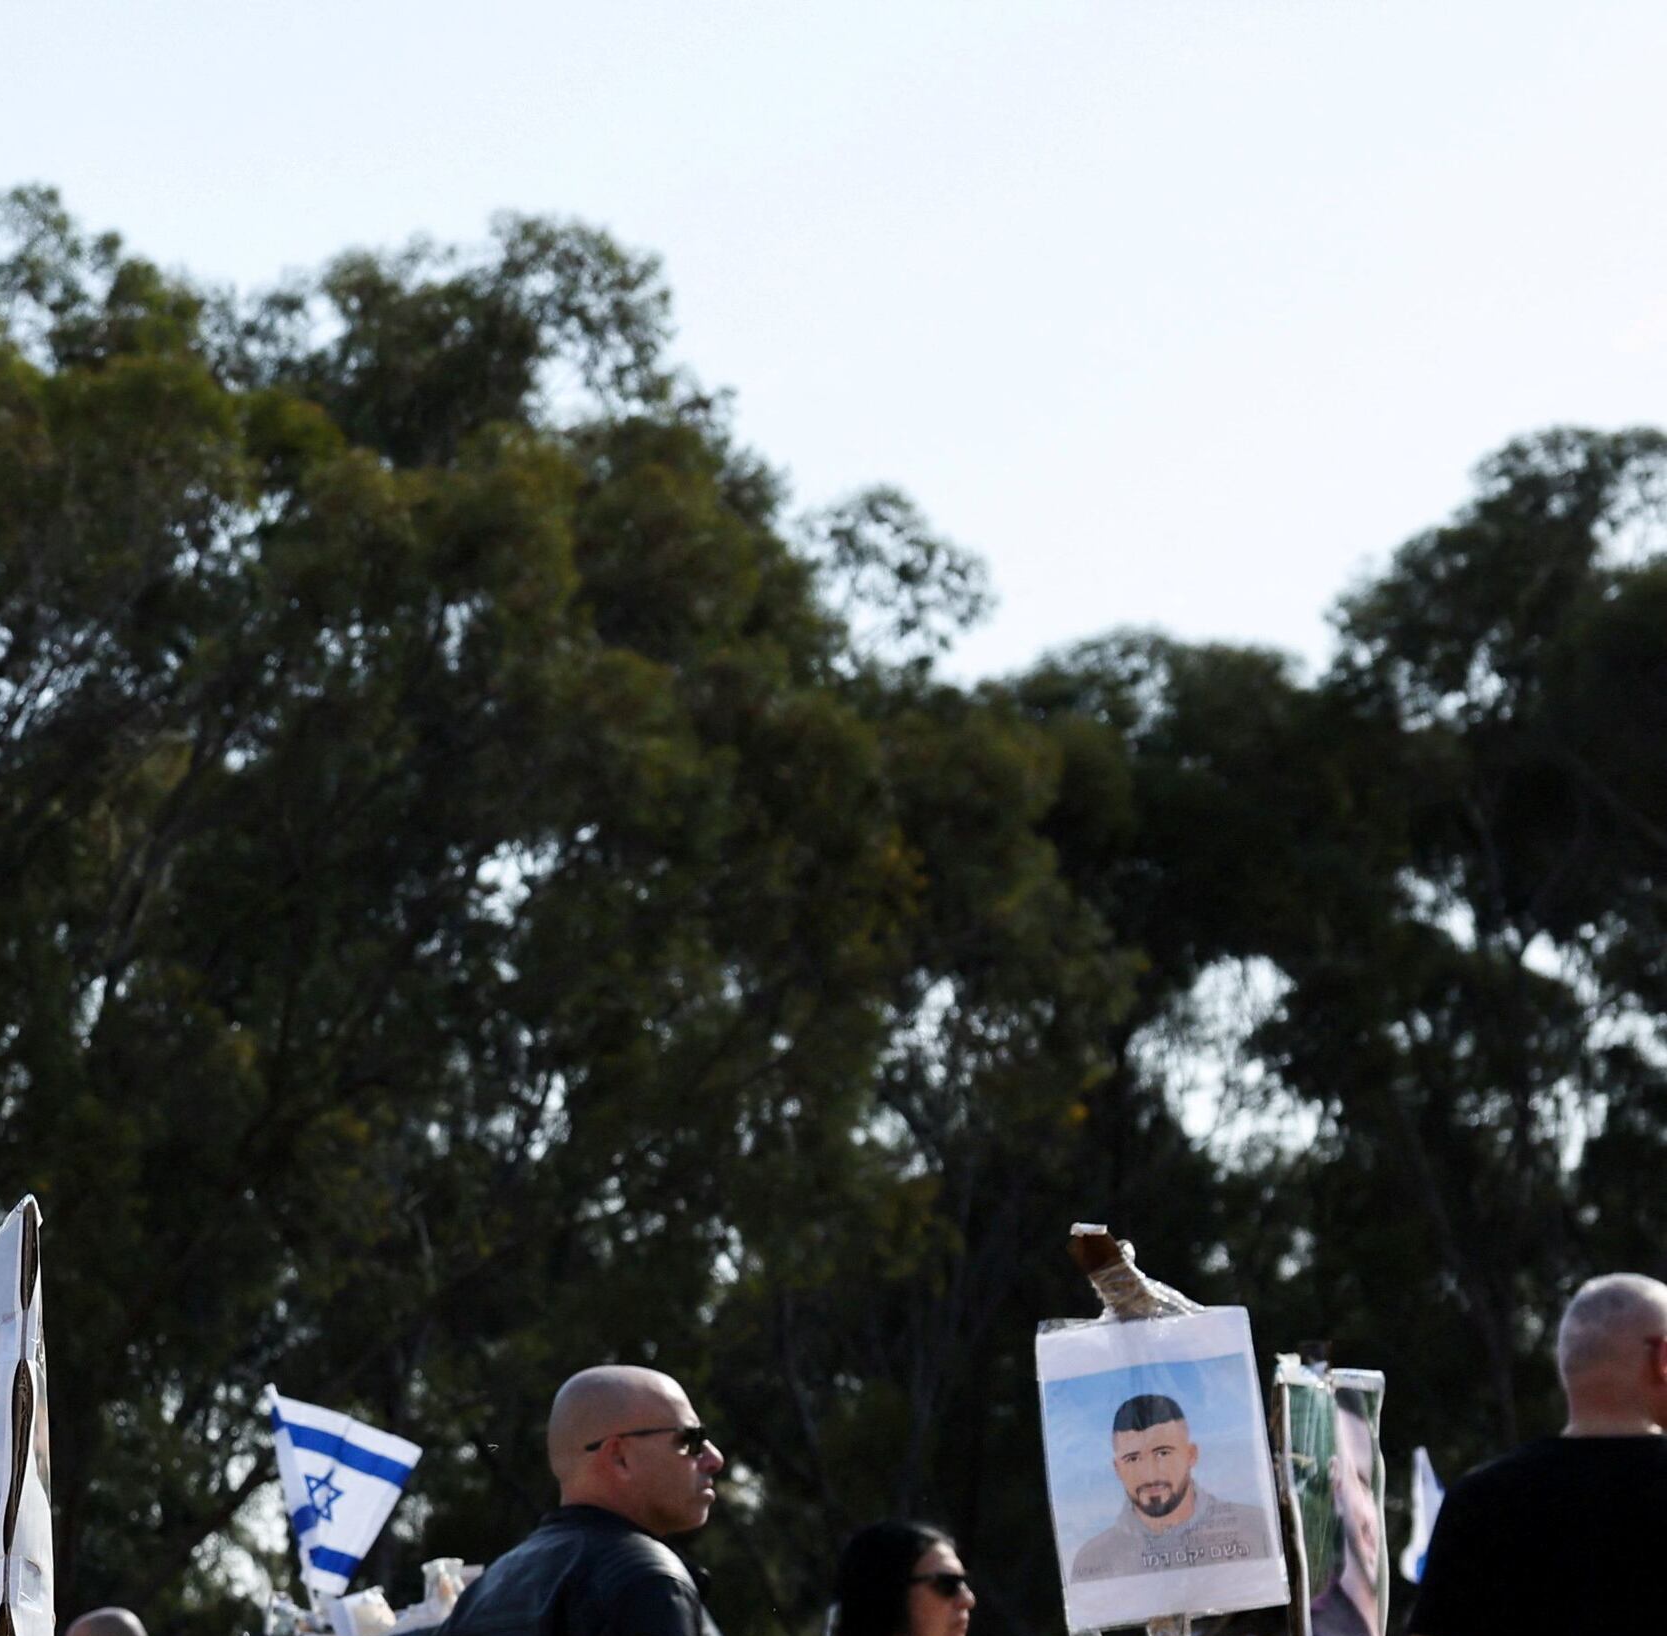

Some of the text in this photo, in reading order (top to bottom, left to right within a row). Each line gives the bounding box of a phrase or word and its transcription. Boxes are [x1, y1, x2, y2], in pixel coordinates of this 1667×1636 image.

[1141, 1542, 1250, 1568] השם יקם דמו
